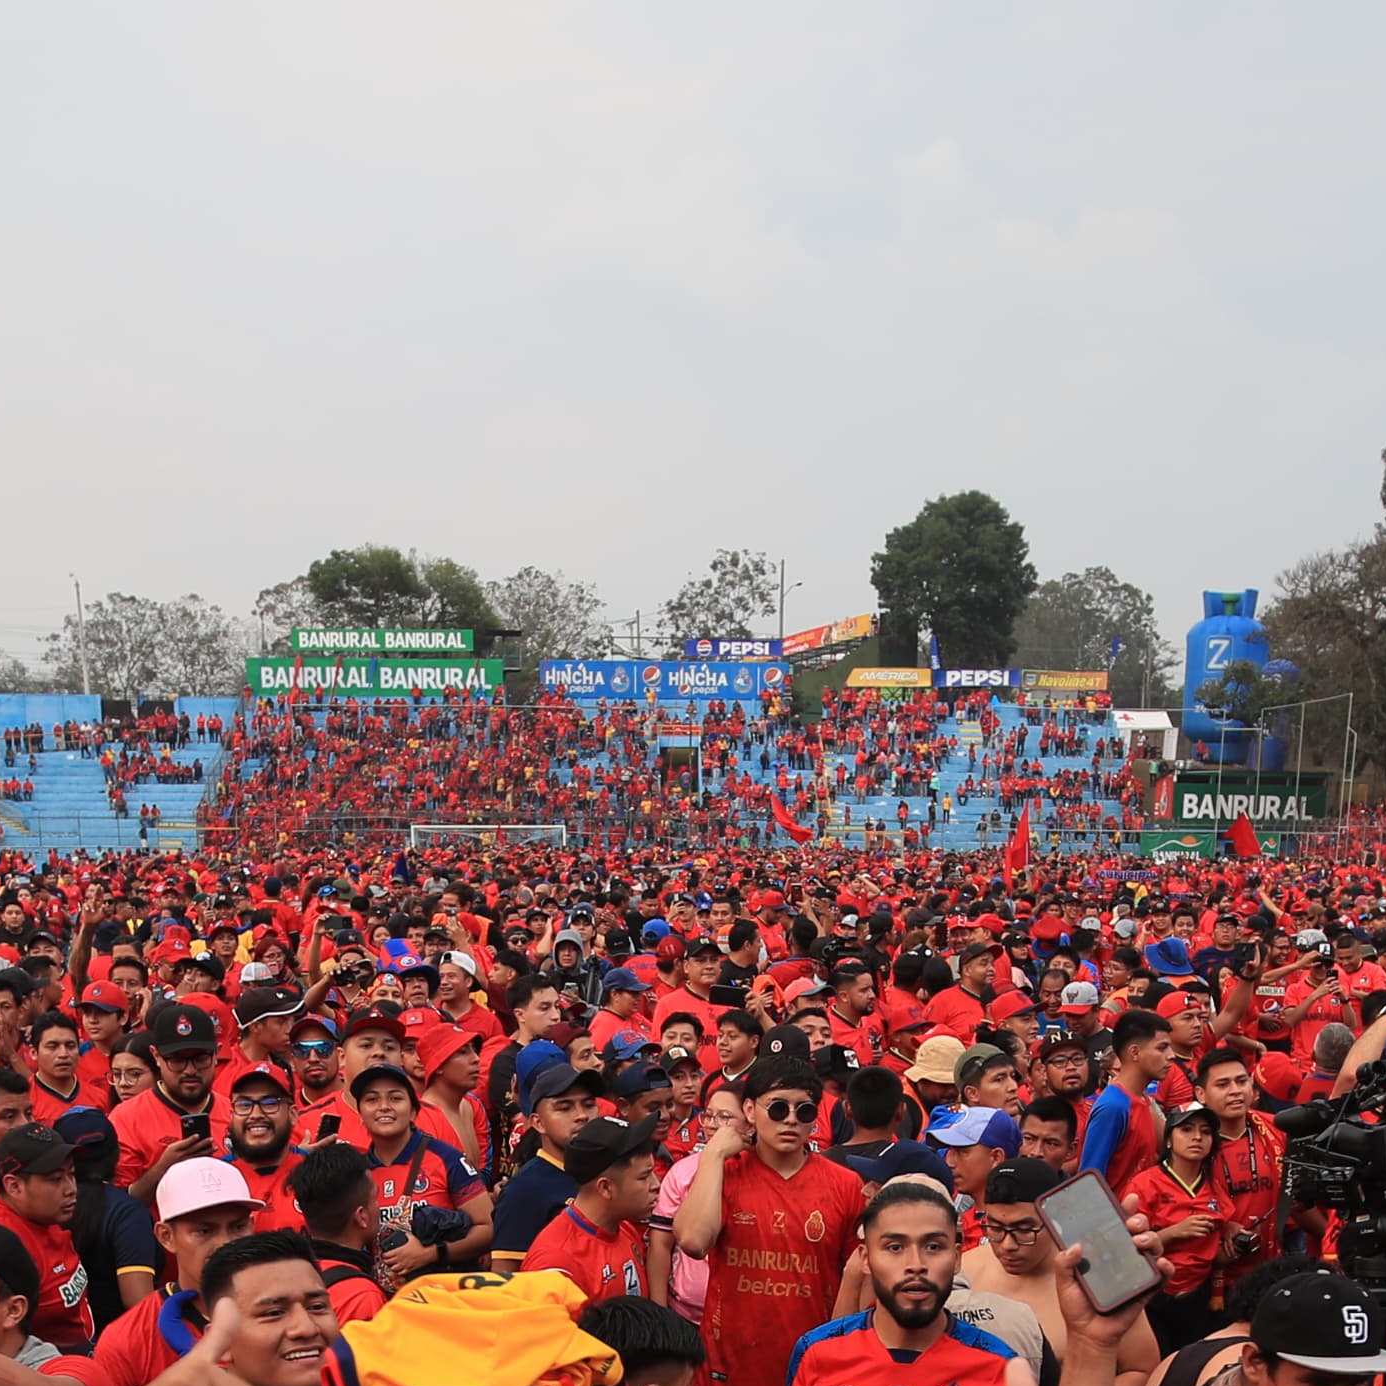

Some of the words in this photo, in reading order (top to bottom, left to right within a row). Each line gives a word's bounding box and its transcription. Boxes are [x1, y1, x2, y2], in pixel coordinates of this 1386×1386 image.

[299, 631, 379, 648] BANRURAL
[385, 632, 466, 649] BANRURAL
[719, 642, 770, 655] PEPSI
[1207, 639, 1230, 669] Z
[260, 666, 370, 688] BANRURAL
[380, 667, 492, 689] BANRURAL
[668, 667, 728, 687] HINCHA
[945, 670, 1010, 686] PEPSI
[1182, 792, 1313, 821] BANRURAL
[725, 1247, 820, 1275] BANRURAL
[736, 1273, 813, 1299] betcris
